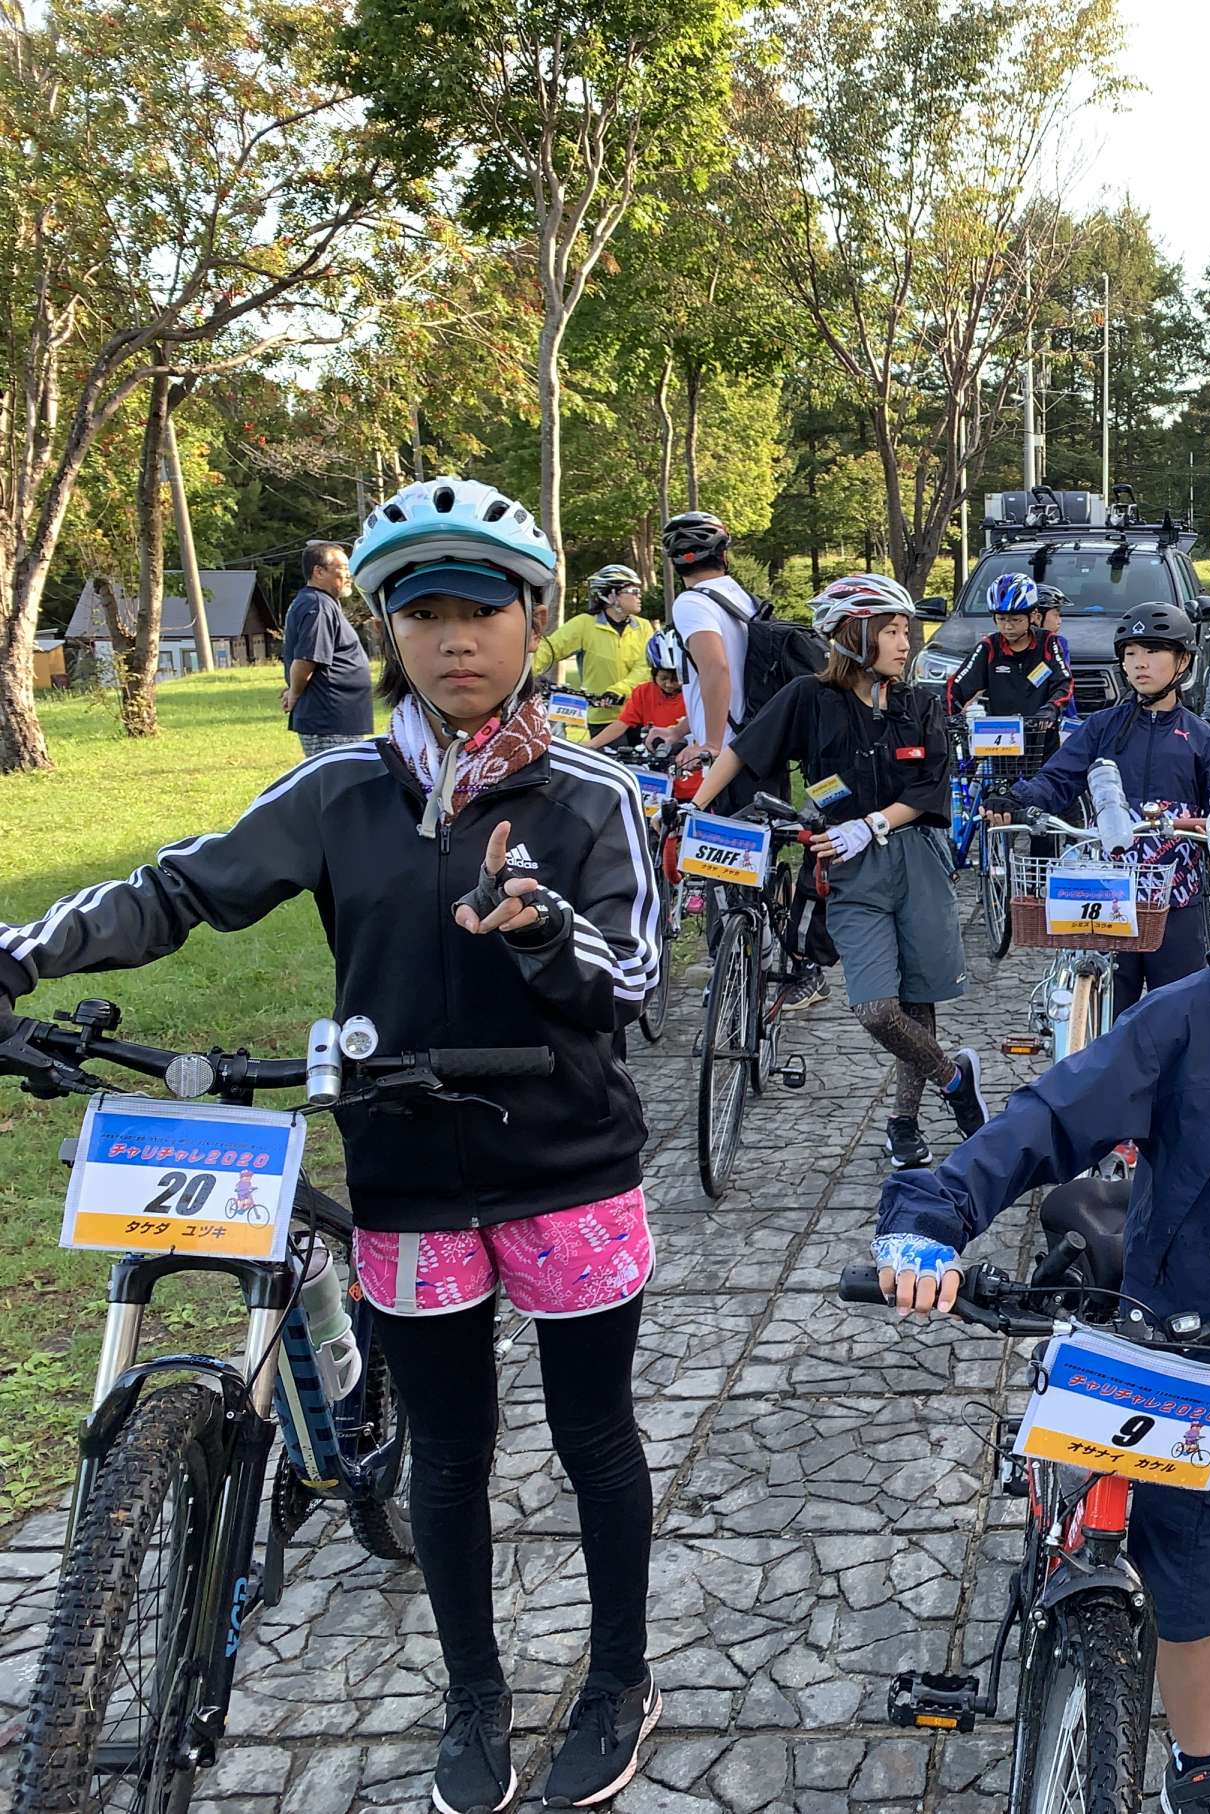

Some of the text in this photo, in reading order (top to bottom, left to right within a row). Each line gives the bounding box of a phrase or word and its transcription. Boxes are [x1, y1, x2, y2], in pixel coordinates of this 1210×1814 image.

[993, 734, 1002, 746] 4
[505, 857, 539, 870] didas
[696, 845, 741, 866] STAFF
[1081, 902, 1102, 920] 18
[108, 1143, 270, 1168] チャリチャレ2020
[143, 1171, 217, 1216] 20
[125, 1220, 170, 1235] タケダ
[1111, 1415, 1155, 1447] 9
[1067, 1441, 1177, 1473] オサナイ カケル
